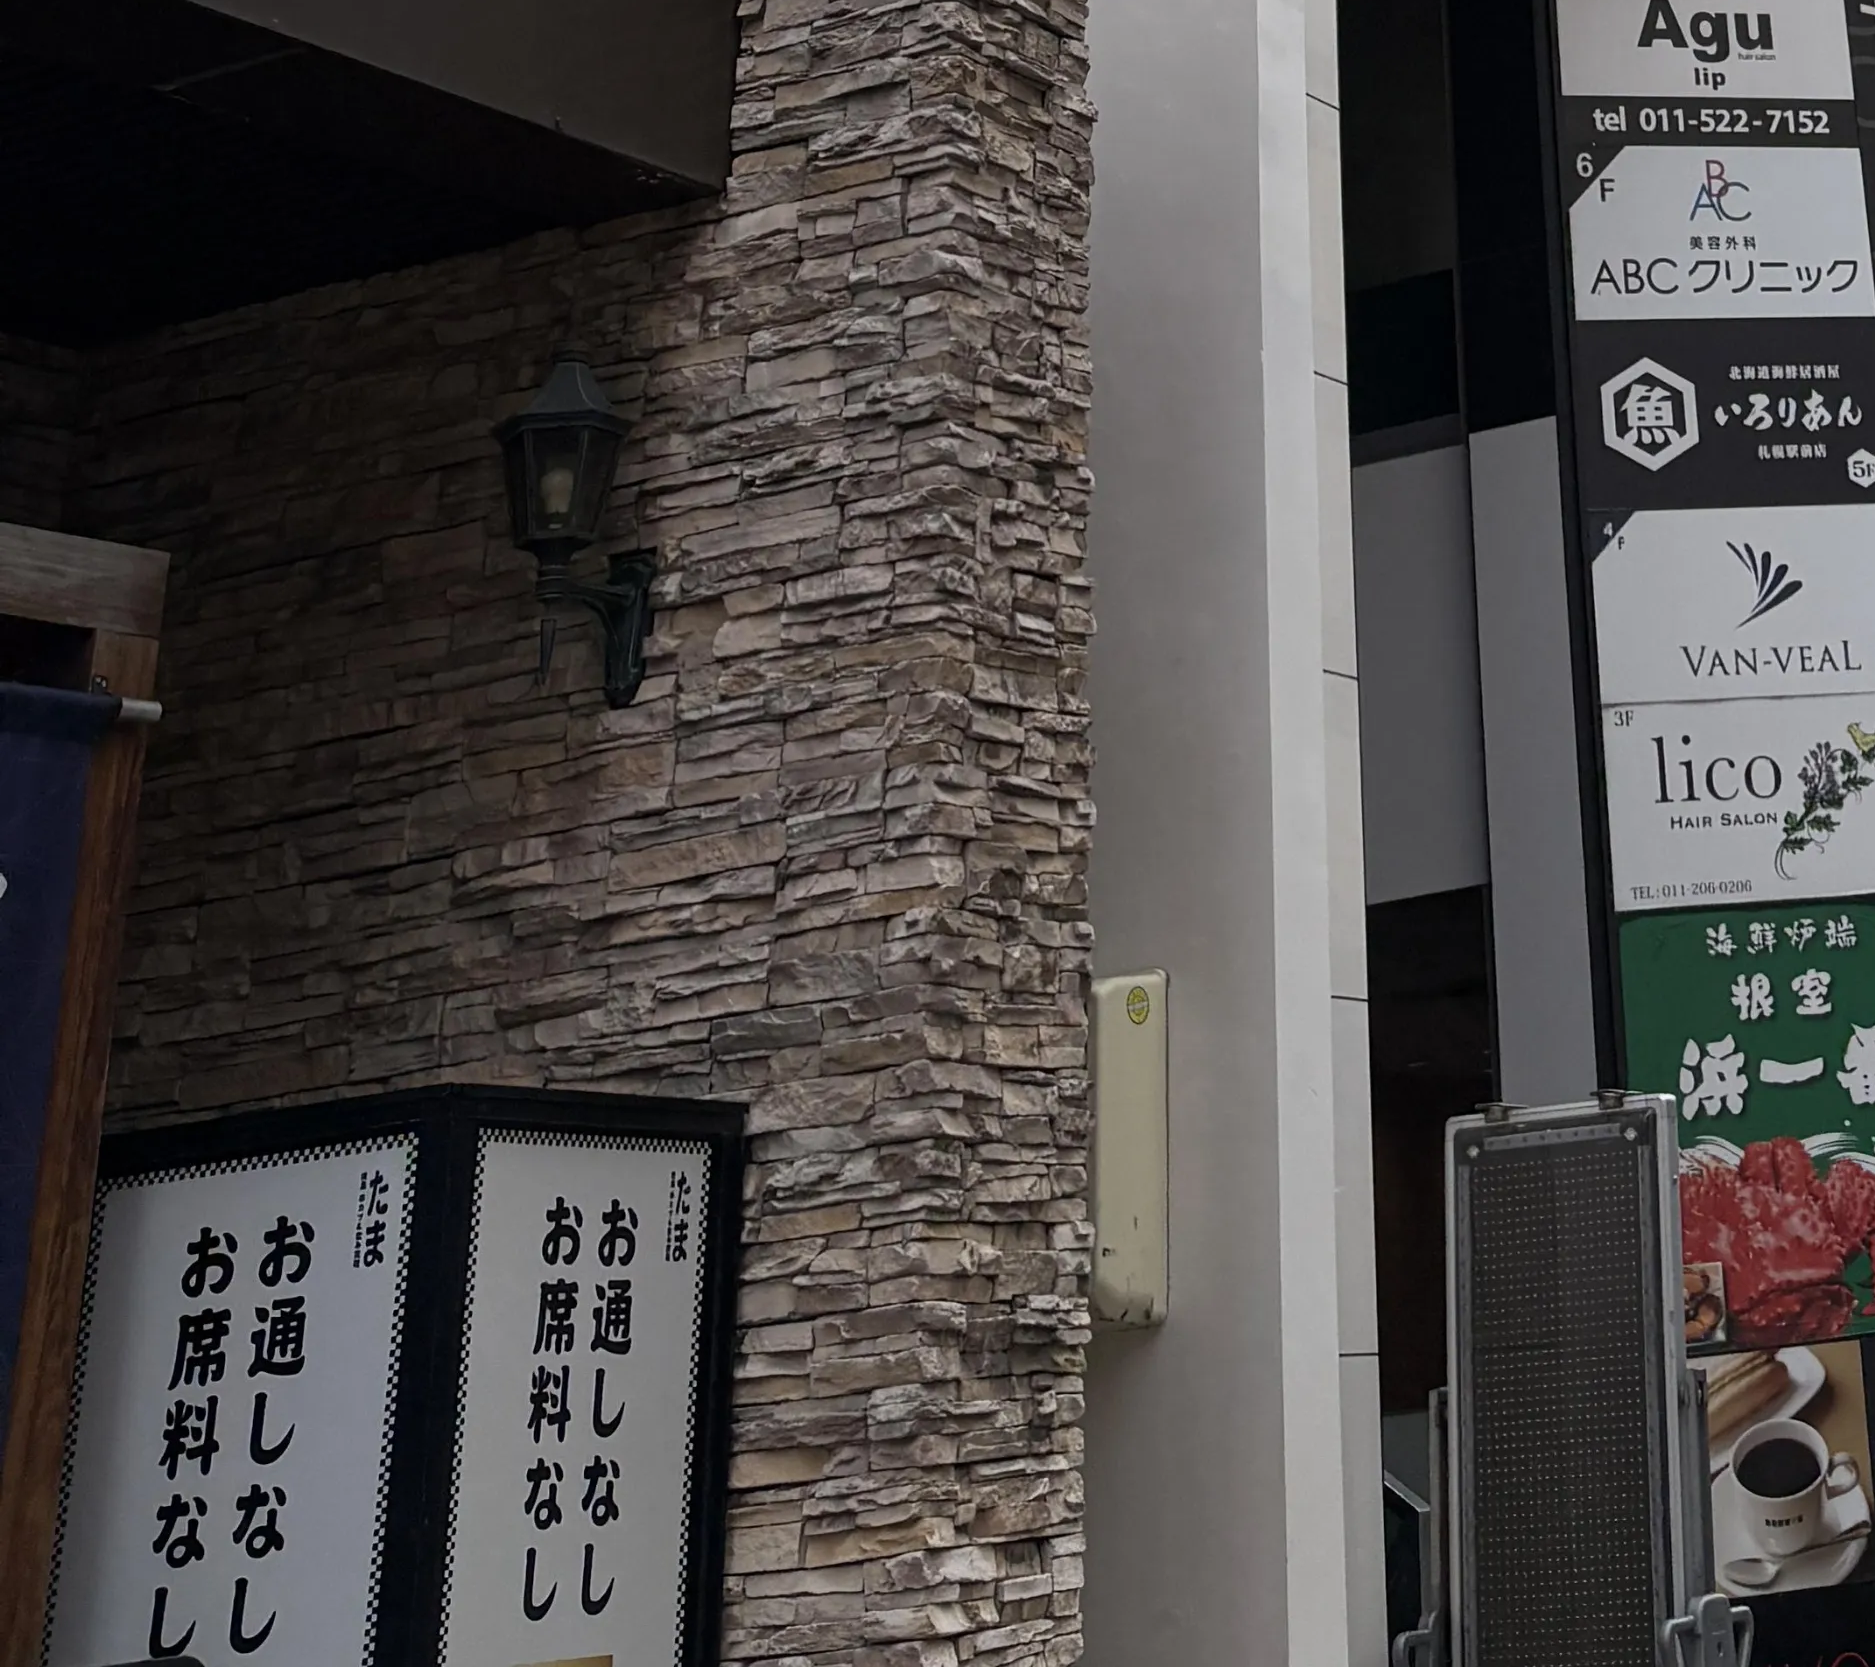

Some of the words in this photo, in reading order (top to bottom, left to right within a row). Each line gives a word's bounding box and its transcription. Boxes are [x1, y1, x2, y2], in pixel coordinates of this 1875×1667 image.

[1694, 67, 1726, 90] lip
[1593, 106, 1626, 132] tel
[1639, 108, 1830, 134] 011-522-7152
[1689, 236, 1757, 251] 美容外科
[1591, 257, 1679, 295] ABC
[1688, 259, 1858, 294] クリニック
[1619, 383, 1681, 445] 魚
[1714, 388, 1863, 432] いろりあん
[1853, 460, 1875, 479] 5F
[1680, 640, 1862, 678] VAN-VEAL
[1613, 710, 1635, 727] 3F
[1651, 735, 1782, 804] lico
[1670, 814, 1713, 830] HAIR
[1720, 811, 1779, 828] SALON
[1730, 968, 1833, 1020] 根室
[364, 1170, 389, 1267] たま
[672, 1171, 691, 1261] たま
[522, 1196, 583, 1621] お席料なし
[581, 1198, 639, 1617] お通しなし
[148, 1226, 239, 1658] お席料なし
[229, 1216, 316, 1654] お通しなし
